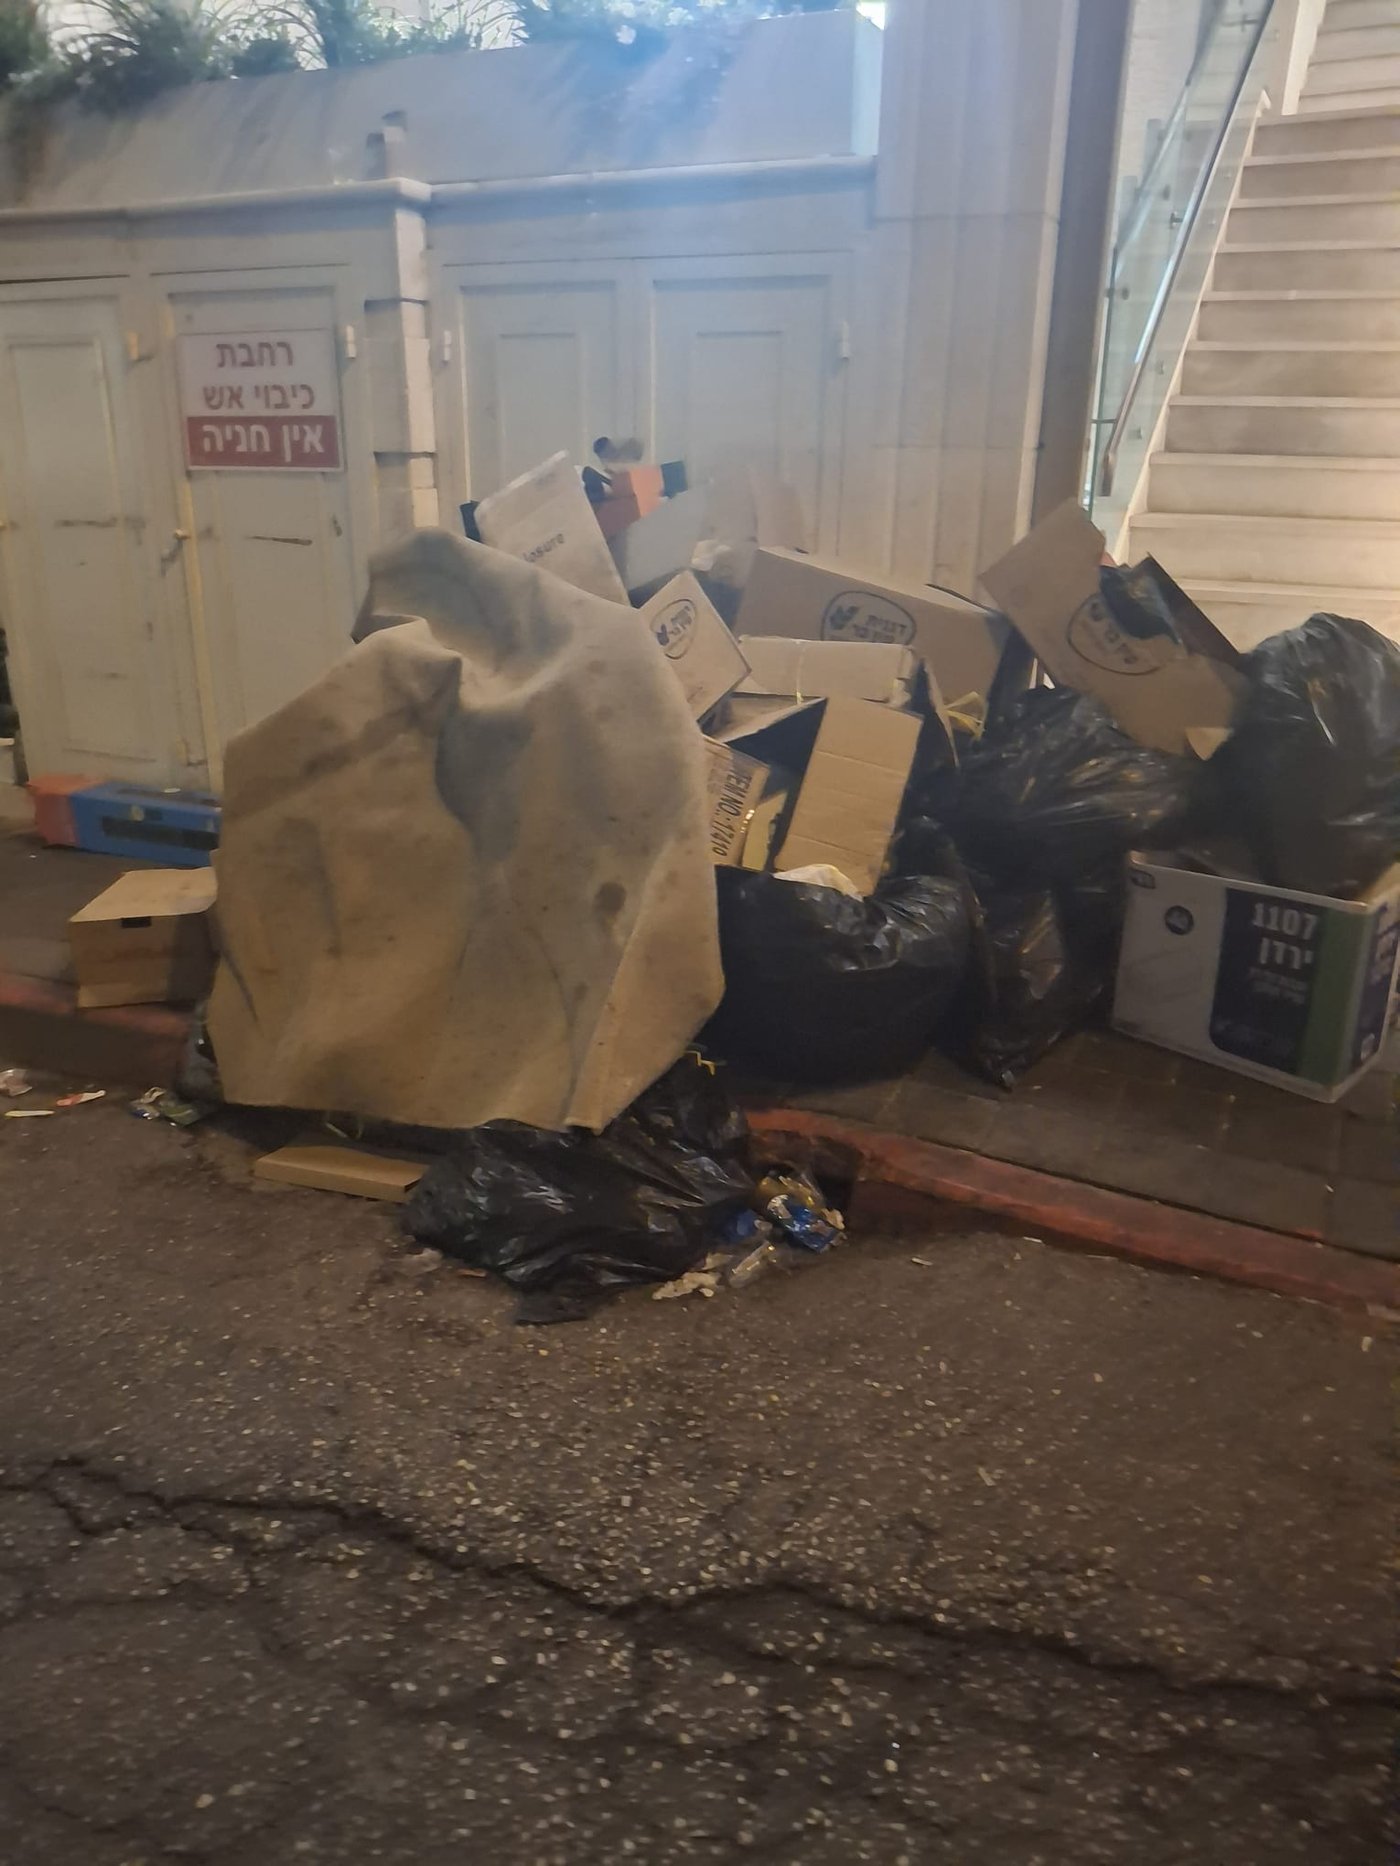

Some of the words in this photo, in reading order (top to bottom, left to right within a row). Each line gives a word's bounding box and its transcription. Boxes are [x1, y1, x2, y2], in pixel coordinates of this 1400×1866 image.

[216, 341, 294, 368] רחבת
[202, 384, 245, 411] אש
[254, 383, 316, 410] כיבוי
[201, 424, 271, 453] חניה
[282, 423, 325, 463] אין
[522, 532, 566, 564] losure
